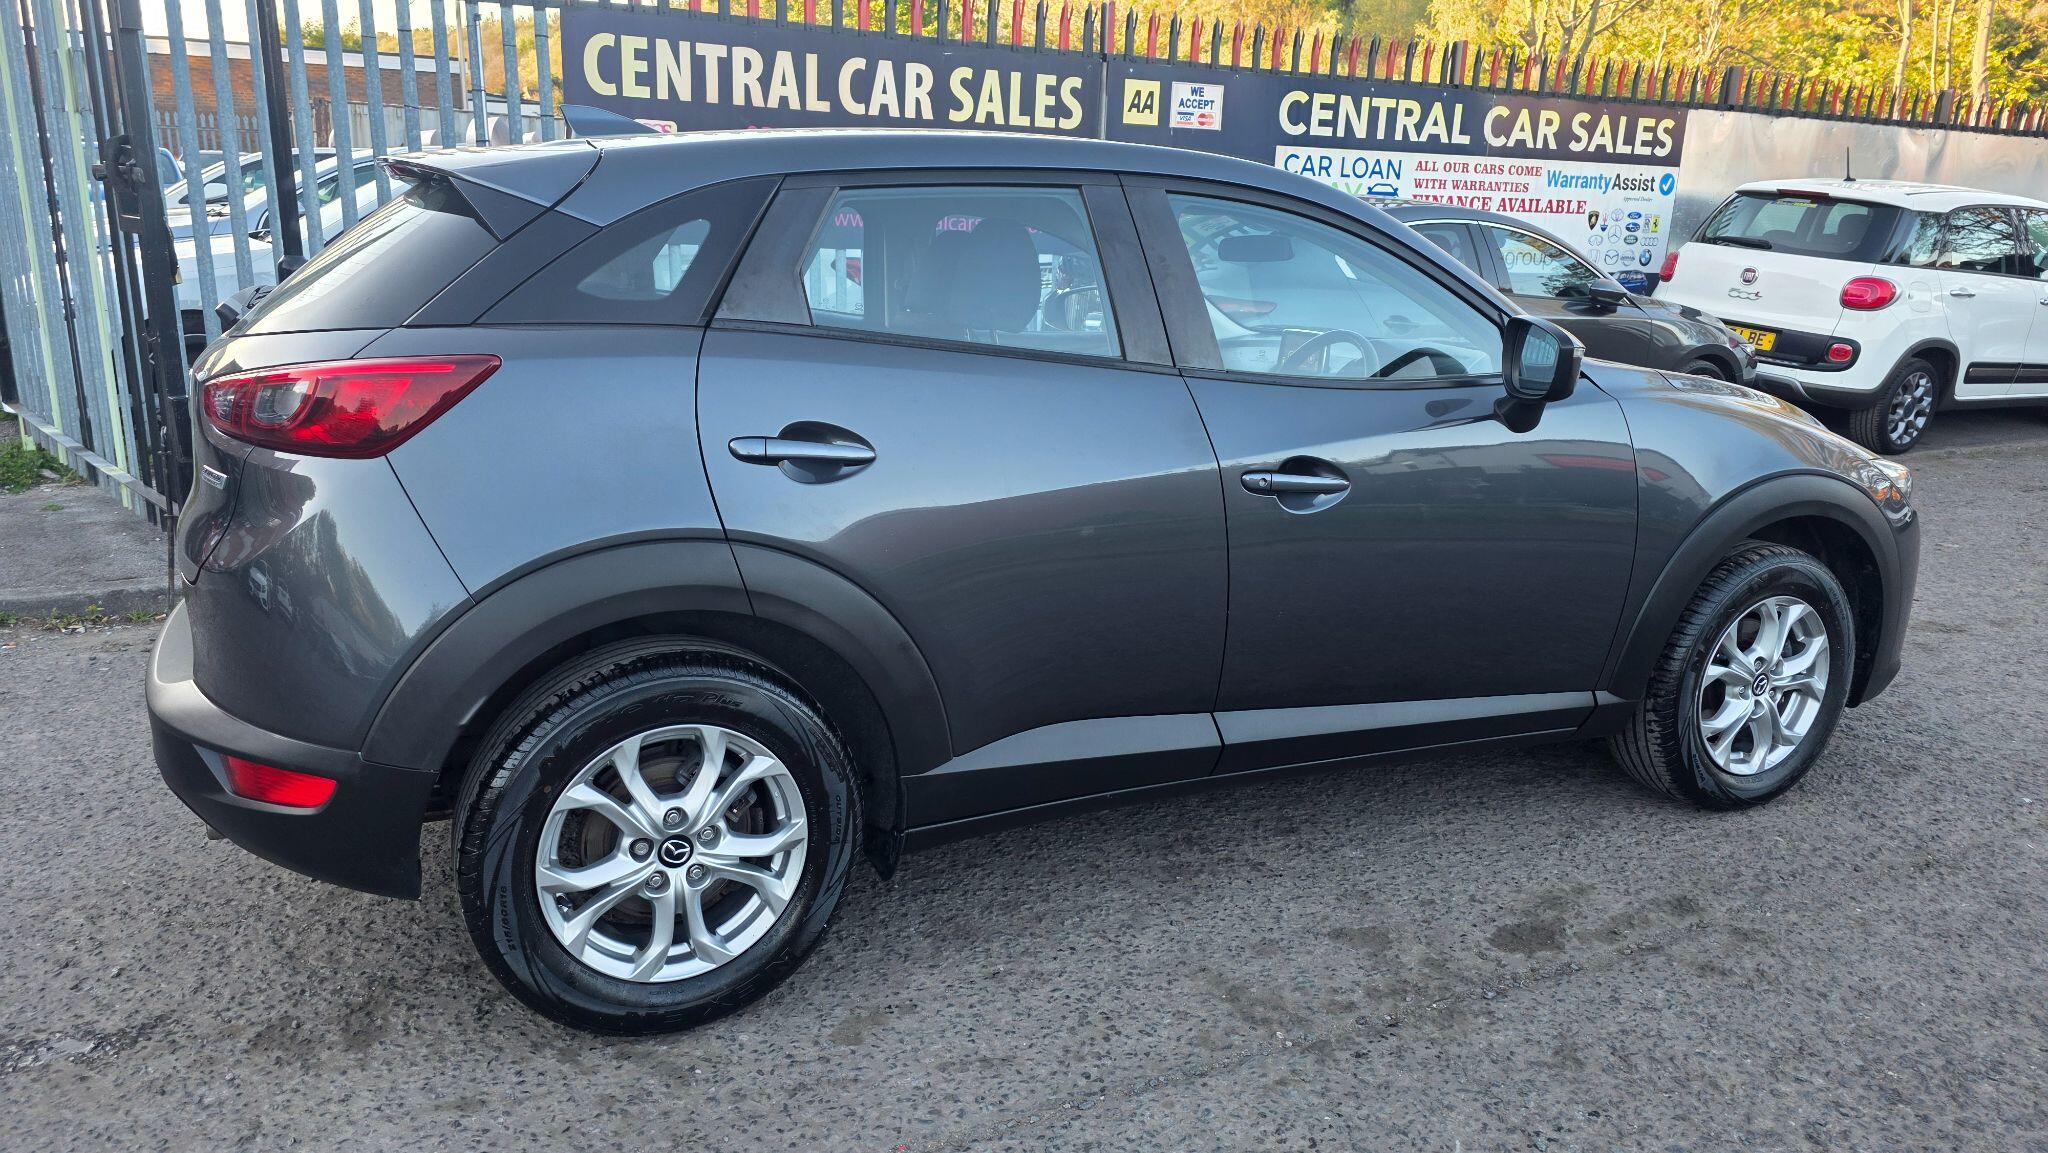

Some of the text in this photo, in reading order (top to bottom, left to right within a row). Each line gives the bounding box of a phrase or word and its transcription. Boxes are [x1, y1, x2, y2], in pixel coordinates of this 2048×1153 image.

[583, 32, 1083, 130] CENTRAL CAR SALES
[1190, 86, 1205, 98] WE
[1127, 89, 1155, 115] AA
[1178, 98, 1215, 111] ACCEPT
[1278, 90, 1676, 157] CENTRAL CAR SALES
[1284, 153, 1403, 180] CAR LOAN
[1415, 160, 1543, 177] ALL OUR CARS COME
[1413, 178, 1530, 193] WITH WARRANTIES
[1495, 197, 1588, 214] AVAILABLE
